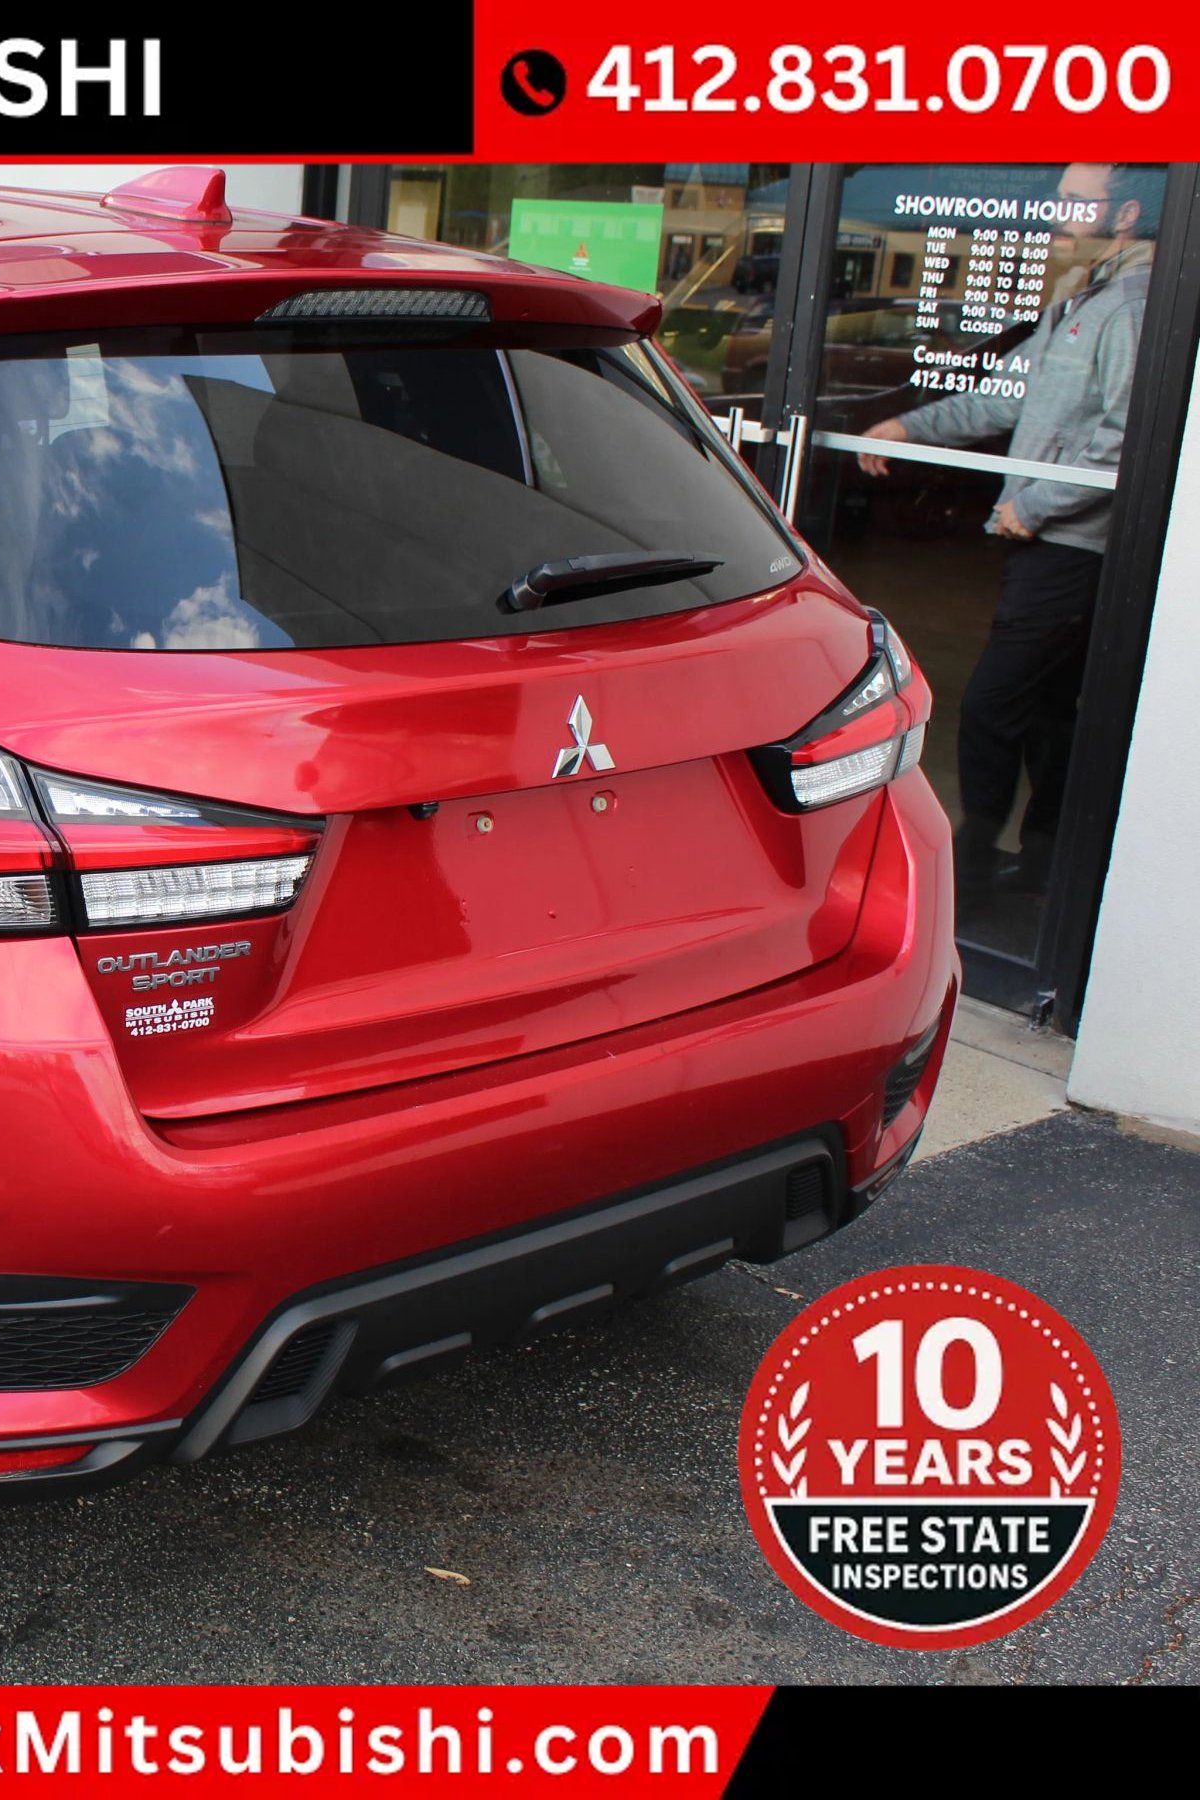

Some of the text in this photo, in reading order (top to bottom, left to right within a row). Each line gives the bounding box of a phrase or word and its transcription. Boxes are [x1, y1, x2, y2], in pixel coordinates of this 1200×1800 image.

[894, 195, 1098, 223] SHOWROOM HOURS
[927, 226, 1050, 245] MON 9:00 TO 8:00
[926, 241, 1048, 261] TUE 9:00 TO 8:00
[924, 257, 1045, 276] WED 9:00 TO 8:00
[922, 271, 1043, 291] THU 9:00 TO 8:00
[919, 286, 1041, 307] FRI 9:00 TO 6:00
[918, 301, 1039, 323] SAT 9:00 TO 5:00
[916, 316, 1003, 335] SUN CLOSED
[913, 344, 1031, 374] Contact Us At
[909, 369, 1025, 399] 412.831.0700
[97, 941, 251, 974] OUTLANDER
[131, 967, 220, 992] SPORT
[125, 997, 213, 1018] SOUTH PARK
[126, 1009, 214, 1028] MITSUBISHI
[130, 1018, 209, 1037] 412-831-0700
